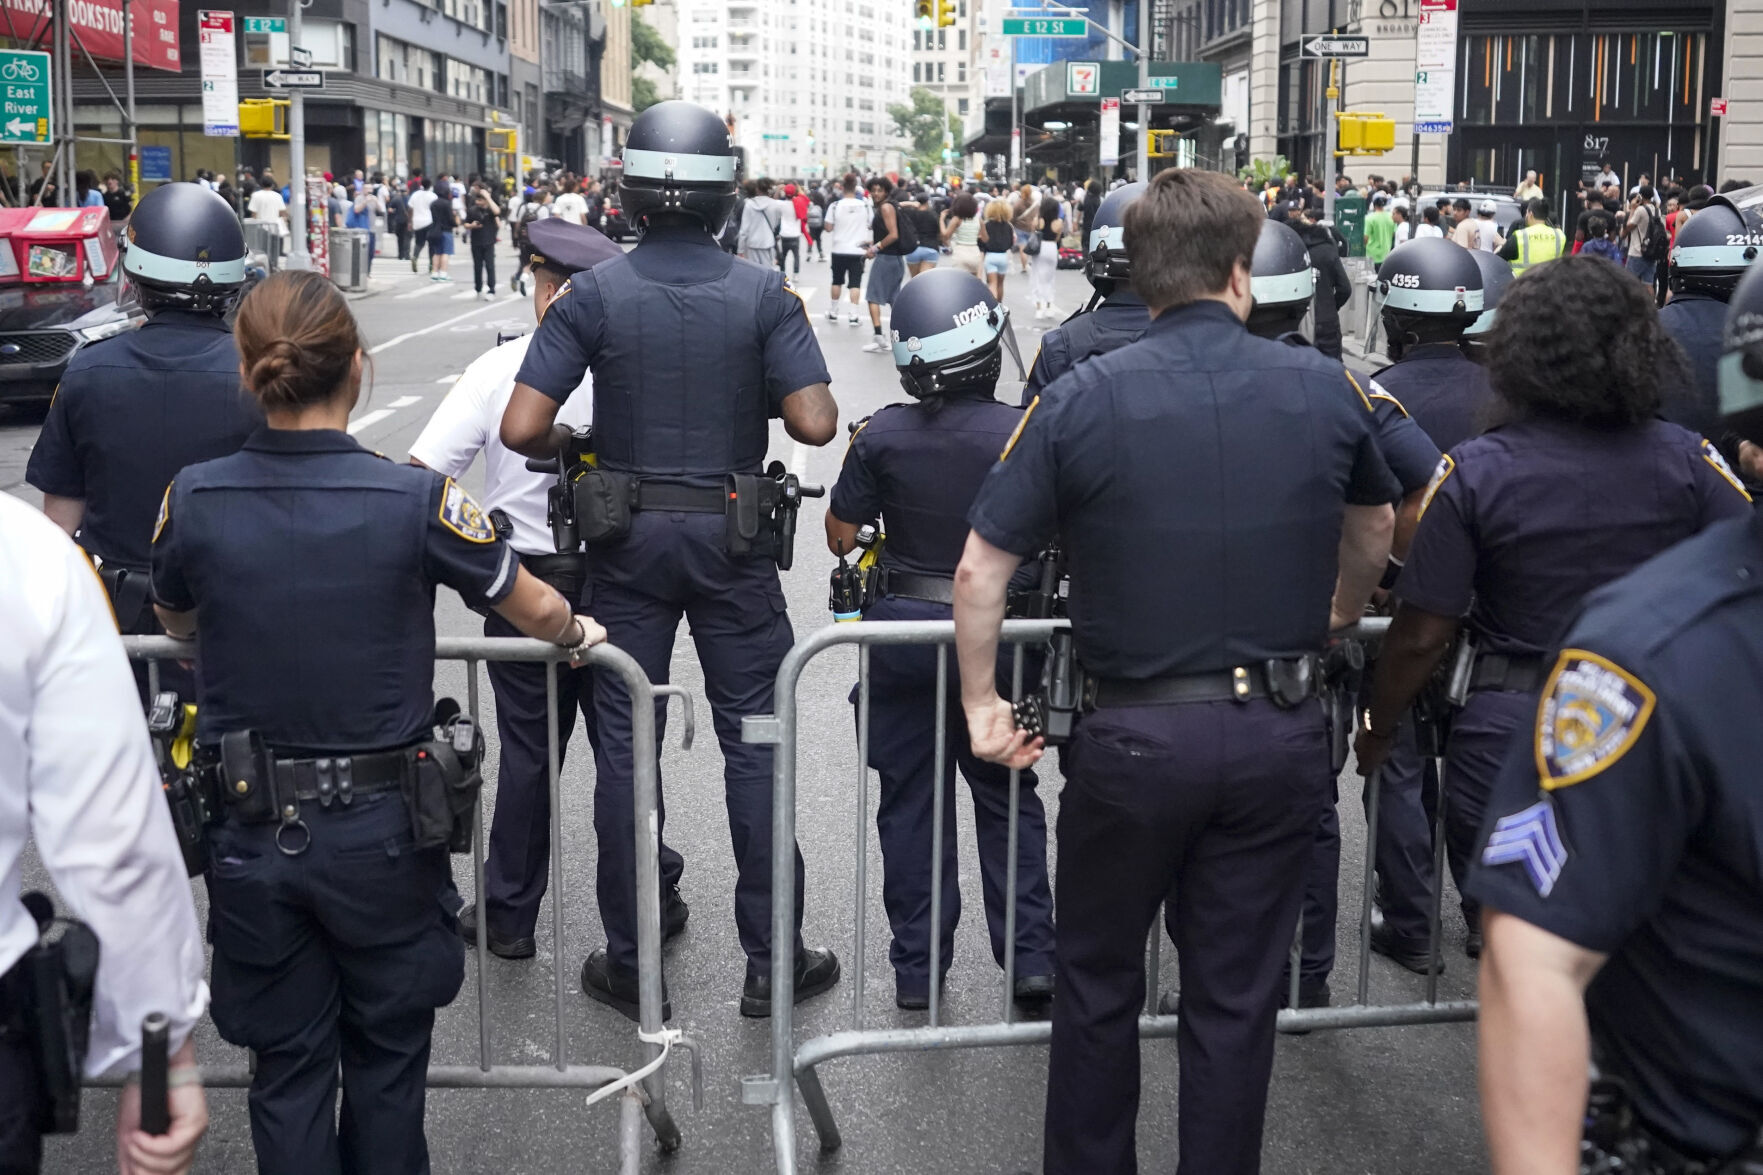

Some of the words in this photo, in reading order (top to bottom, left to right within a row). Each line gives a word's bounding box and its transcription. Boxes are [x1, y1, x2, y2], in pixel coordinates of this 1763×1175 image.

[69, 0, 134, 37] OOKSTORE
[250, 20, 257, 31] E
[261, 20, 271, 31] 12
[1023, 21, 1031, 33] E
[1036, 21, 1048, 33] 12
[1052, 21, 1065, 33] St
[1377, 24, 1418, 33] BROADW
[1314, 42, 1333, 51] ONE
[1342, 42, 1361, 51] WAY
[272, 75, 288, 83] ONE
[7, 86, 35, 98] East
[5, 101, 38, 114] River
[1584, 133, 1609, 158] 817
[1392, 273, 1420, 288] 4355
[953, 301, 989, 328] 10208
